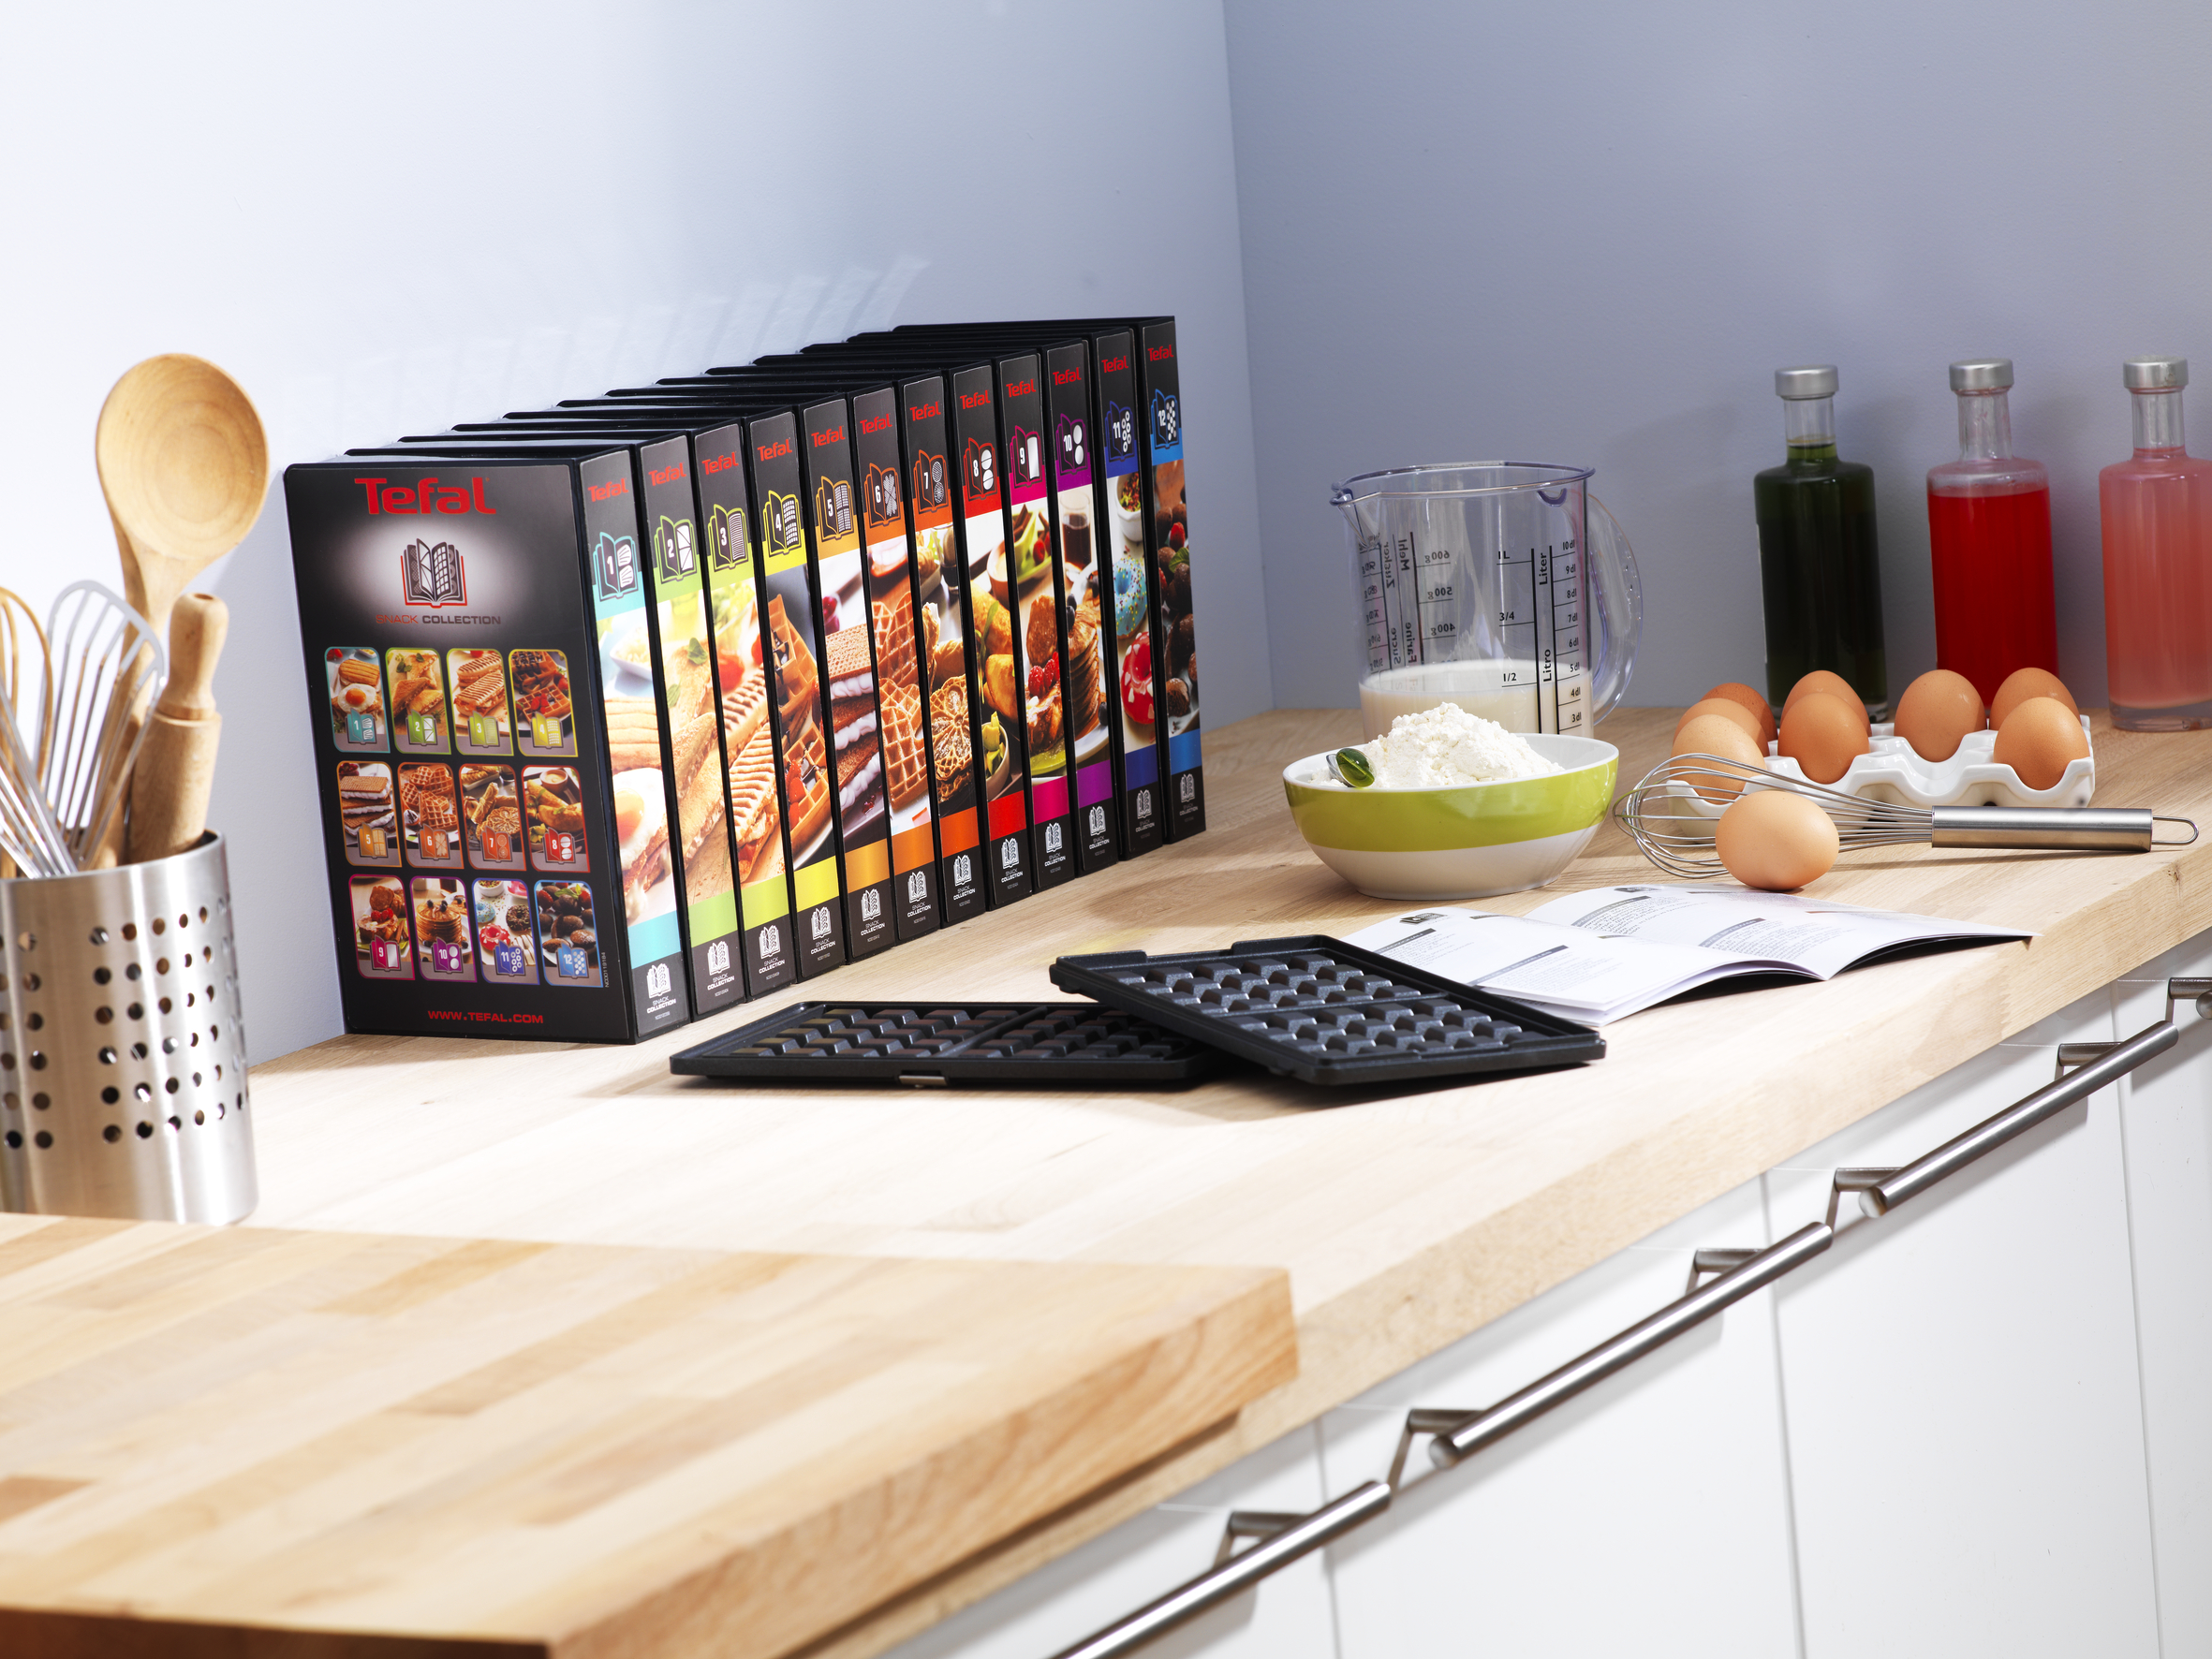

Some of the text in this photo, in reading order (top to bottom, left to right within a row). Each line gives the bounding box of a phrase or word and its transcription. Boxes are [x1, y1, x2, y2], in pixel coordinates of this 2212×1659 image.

[1148, 345, 1173, 360] Tefal
[1102, 356, 1128, 373] Tefal
[1053, 367, 1082, 385] Tefal
[1006, 379, 1036, 397] Tefal
[960, 389, 991, 409] Tefal
[910, 402, 941, 421] Tefal
[1158, 410, 1166, 427] 12
[860, 414, 892, 434] Tefal
[1113, 422, 1121, 438] 11
[811, 426, 845, 447] Tefal
[1063, 434, 1072, 452] 10
[758, 439, 792, 461] Tefal
[1019, 448, 1025, 464] 9
[702, 452, 739, 475] Tefal
[973, 460, 979, 477] 8
[649, 462, 686, 486] Tefal
[923, 472, 930, 490] 7
[355, 477, 496, 514] Tefal
[588, 478, 628, 502] Tefal
[875, 486, 881, 503] 6
[827, 498, 833, 517] 5
[775, 513, 782, 532] 4
[720, 527, 728, 546] 3
[667, 539, 674, 558] 2
[606, 556, 614, 575] 1
[1539, 552, 1548, 585] Liter
[376, 615, 501, 624] SNACK COLLECTION
[1498, 611, 1515, 622] 3/4
[1543, 649, 1552, 683] Litro
[1503, 672, 1517, 682] 1/2
[353, 720, 360, 731] 1
[415, 721, 420, 732] 2
[477, 723, 482, 733] 3
[539, 724, 545, 735] 4
[366, 833, 372, 844] 5
[427, 835, 433, 846] 6
[489, 837, 494, 848] 7
[552, 839, 557, 850] 8
[1044, 856, 1066, 867] COLLECTION
[1001, 871, 1024, 883] COLLECTION
[953, 888, 976, 901] COLLECTION
[907, 904, 932, 918] COLLECTION
[861, 922, 885, 936] COLLECTION
[378, 946, 384, 957] 9
[438, 948, 448, 960] 10
[811, 940, 835, 955] COLLECTION
[500, 951, 509, 962] 11
[564, 954, 572, 964] 12
[763, 957, 779, 966] SNACK
[759, 959, 785, 974] COLLECTION
[707, 976, 735, 991] COLLECTION
[713, 973, 728, 983] SNACK
[647, 998, 676, 1014] COLLECTION
[652, 995, 670, 1006] SNACK
[428, 1011, 544, 1023] WWW.TEFAL.COM
